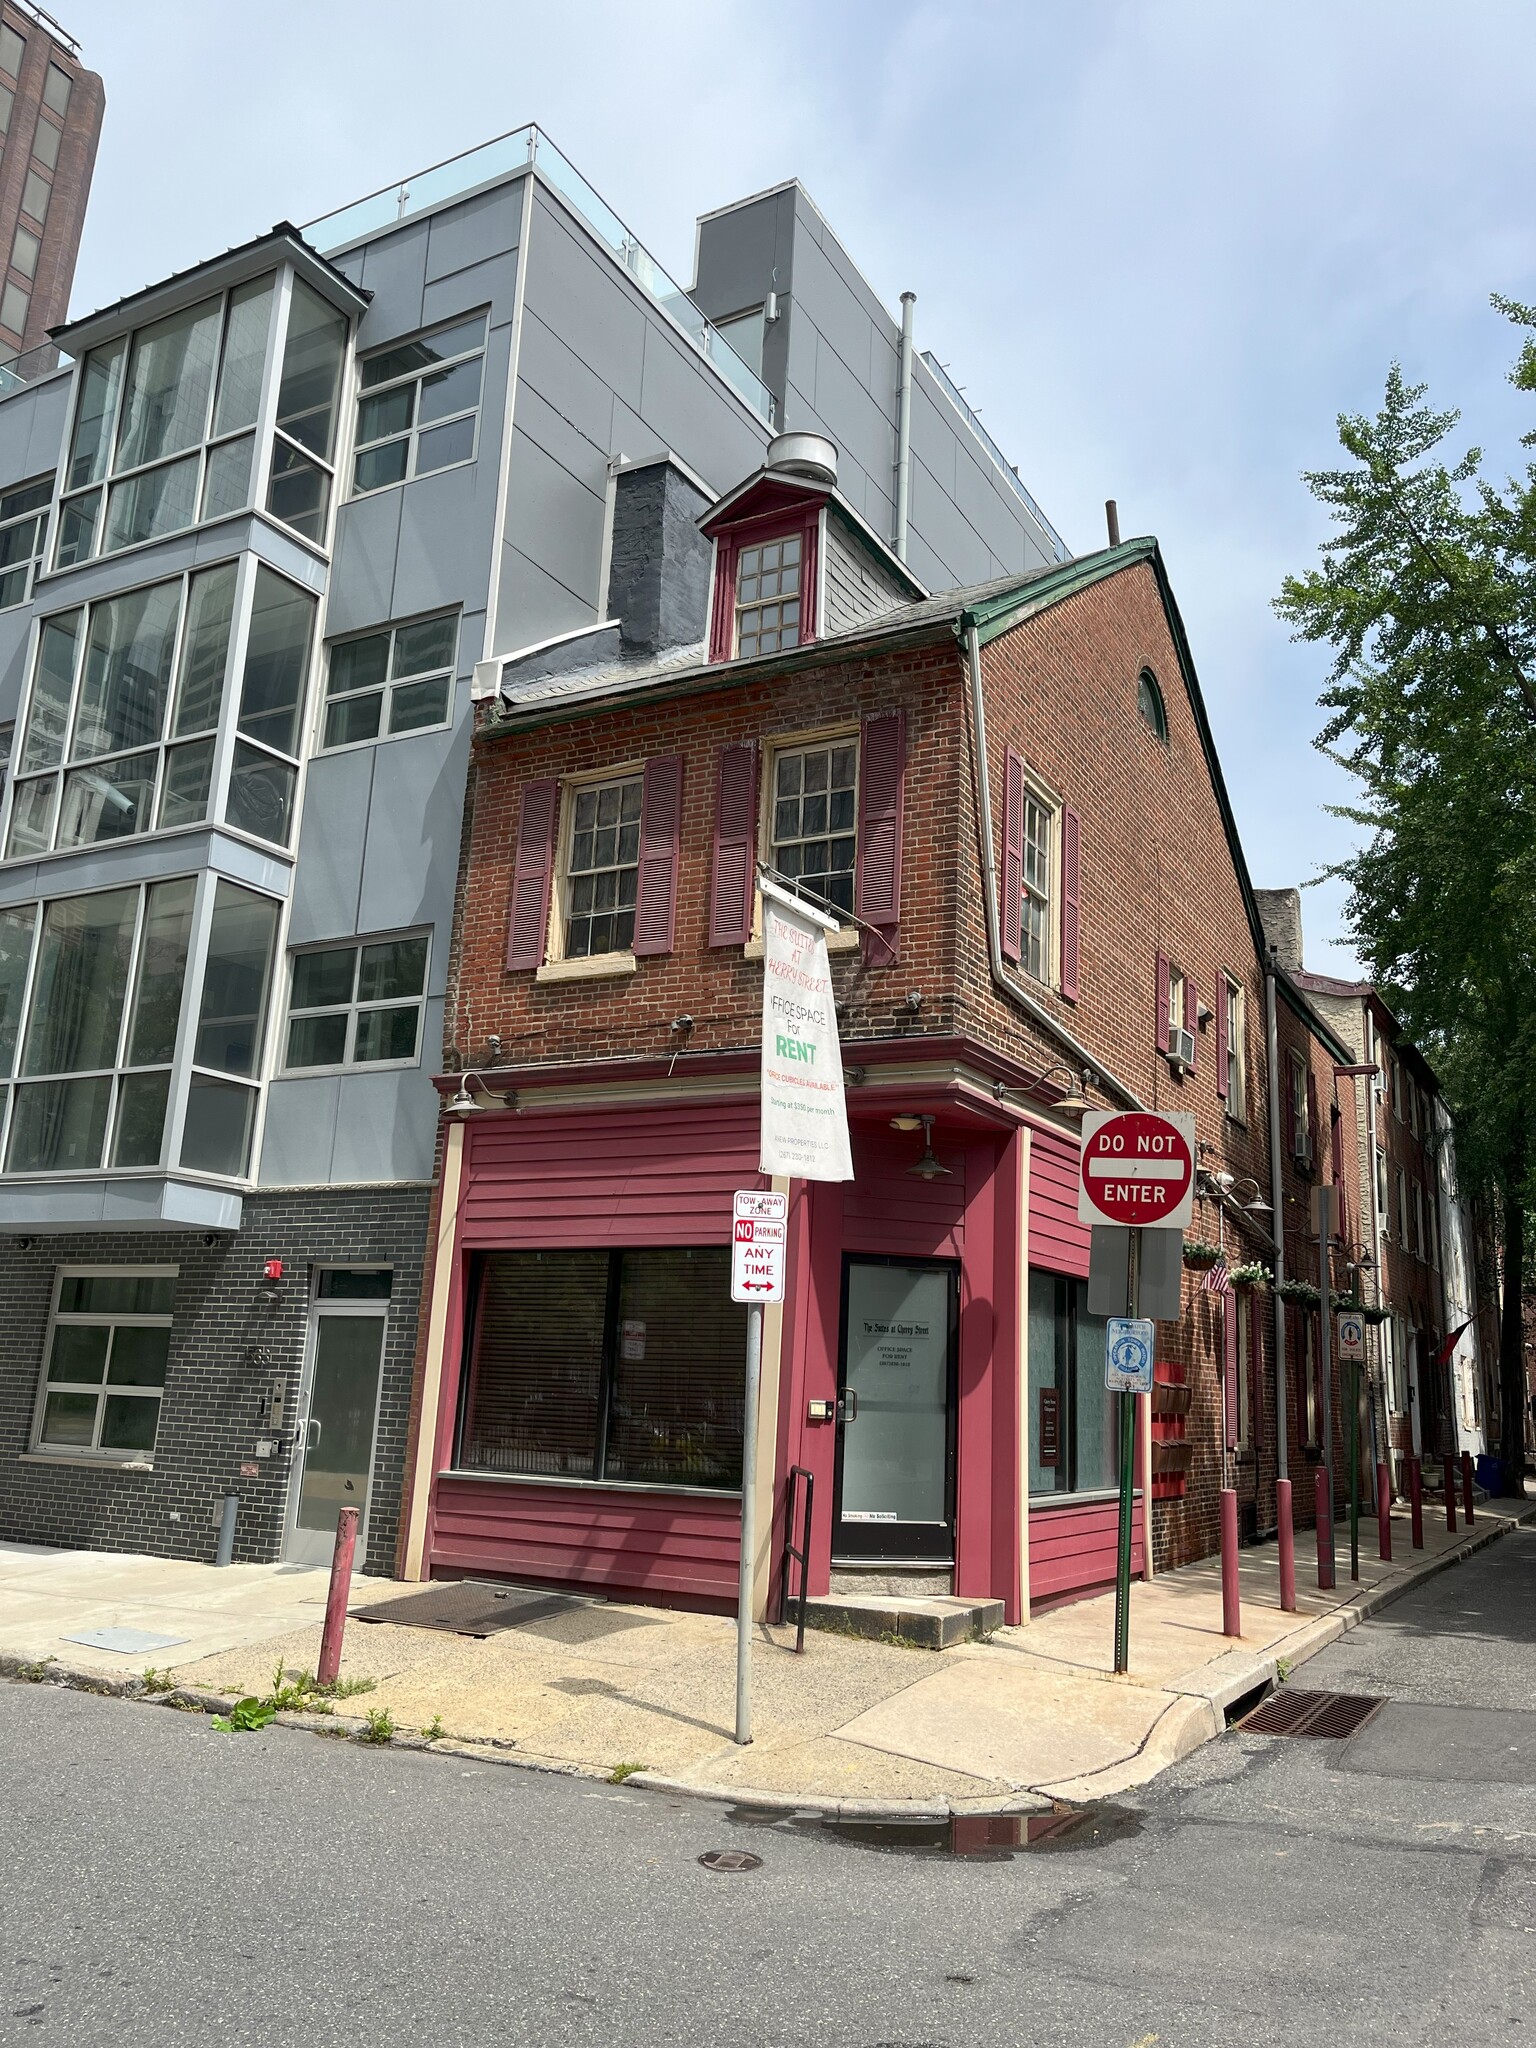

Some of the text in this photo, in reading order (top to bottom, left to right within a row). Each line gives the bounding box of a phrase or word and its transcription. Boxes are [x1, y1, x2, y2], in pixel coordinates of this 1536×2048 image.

[774, 920, 788, 940] THE
[791, 949, 802, 965] AT
[798, 971, 829, 993] STREET
[771, 995, 826, 1026] FFICE SPACE
[787, 1019, 801, 1035] For
[776, 1034, 817, 1065] RENT
[787, 1101, 794, 1109] at
[807, 1106, 815, 1114] per
[815, 1107, 835, 1116] month
[1099, 1134, 1176, 1153] DO NOT
[1104, 1184, 1166, 1204] ENTER
[749, 1206, 772, 1216] ZONE
[736, 1222, 782, 1239] NO PARKING
[744, 1247, 774, 1259] ANY
[744, 1263, 774, 1276] TIME
